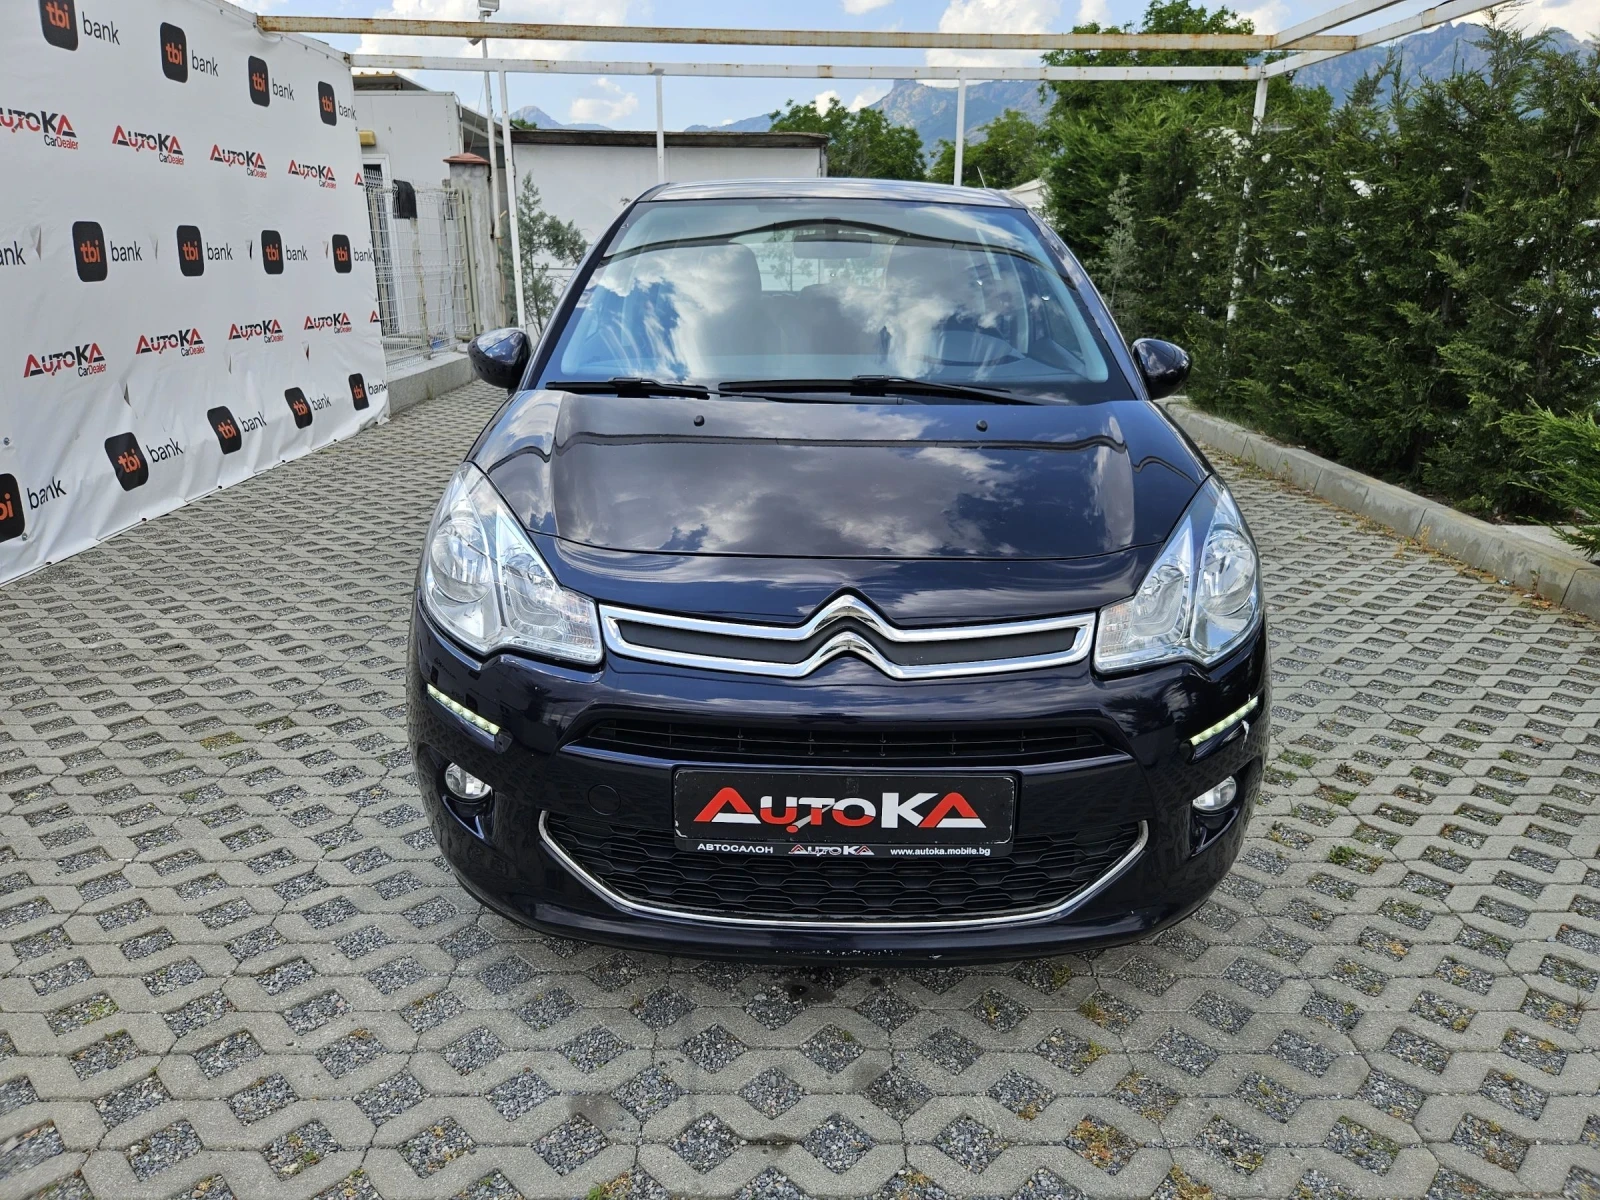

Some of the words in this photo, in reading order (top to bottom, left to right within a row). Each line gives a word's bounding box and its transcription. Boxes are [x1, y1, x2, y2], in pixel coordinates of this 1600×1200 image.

[46, 2, 71, 30] tbi
[82, 11, 120, 45] bank
[166, 42, 183, 66] tbi
[191, 50, 219, 77] bank
[252, 72, 266, 92] tbi
[272, 79, 294, 101] bank
[321, 96, 334, 113] tbi
[338, 101, 357, 121] bank
[0, 107, 77, 138] UTOKA
[0, 240, 26, 266] ank
[80, 240, 101, 264] tbi
[110, 241, 143, 262] bank
[182, 241, 199, 261] tbi
[206, 242, 233, 261] bank
[266, 243, 280, 261] tbi
[286, 245, 309, 261] bank
[336, 246, 348, 262] tbi
[353, 246, 375, 262] bank
[353, 383, 364, 399] tbi
[368, 379, 389, 396] bank
[292, 398, 308, 416] tbi
[310, 394, 332, 411] bank
[218, 419, 237, 440] tbi
[118, 448, 141, 473] tbi
[146, 438, 184, 463] bank
[27, 476, 67, 510] bank
[693, 787, 987, 833] AUTOKA
[697, 843, 773, 854] АВТОСАЛОН
[890, 846, 991, 857] www.autoka.mobile.bg
